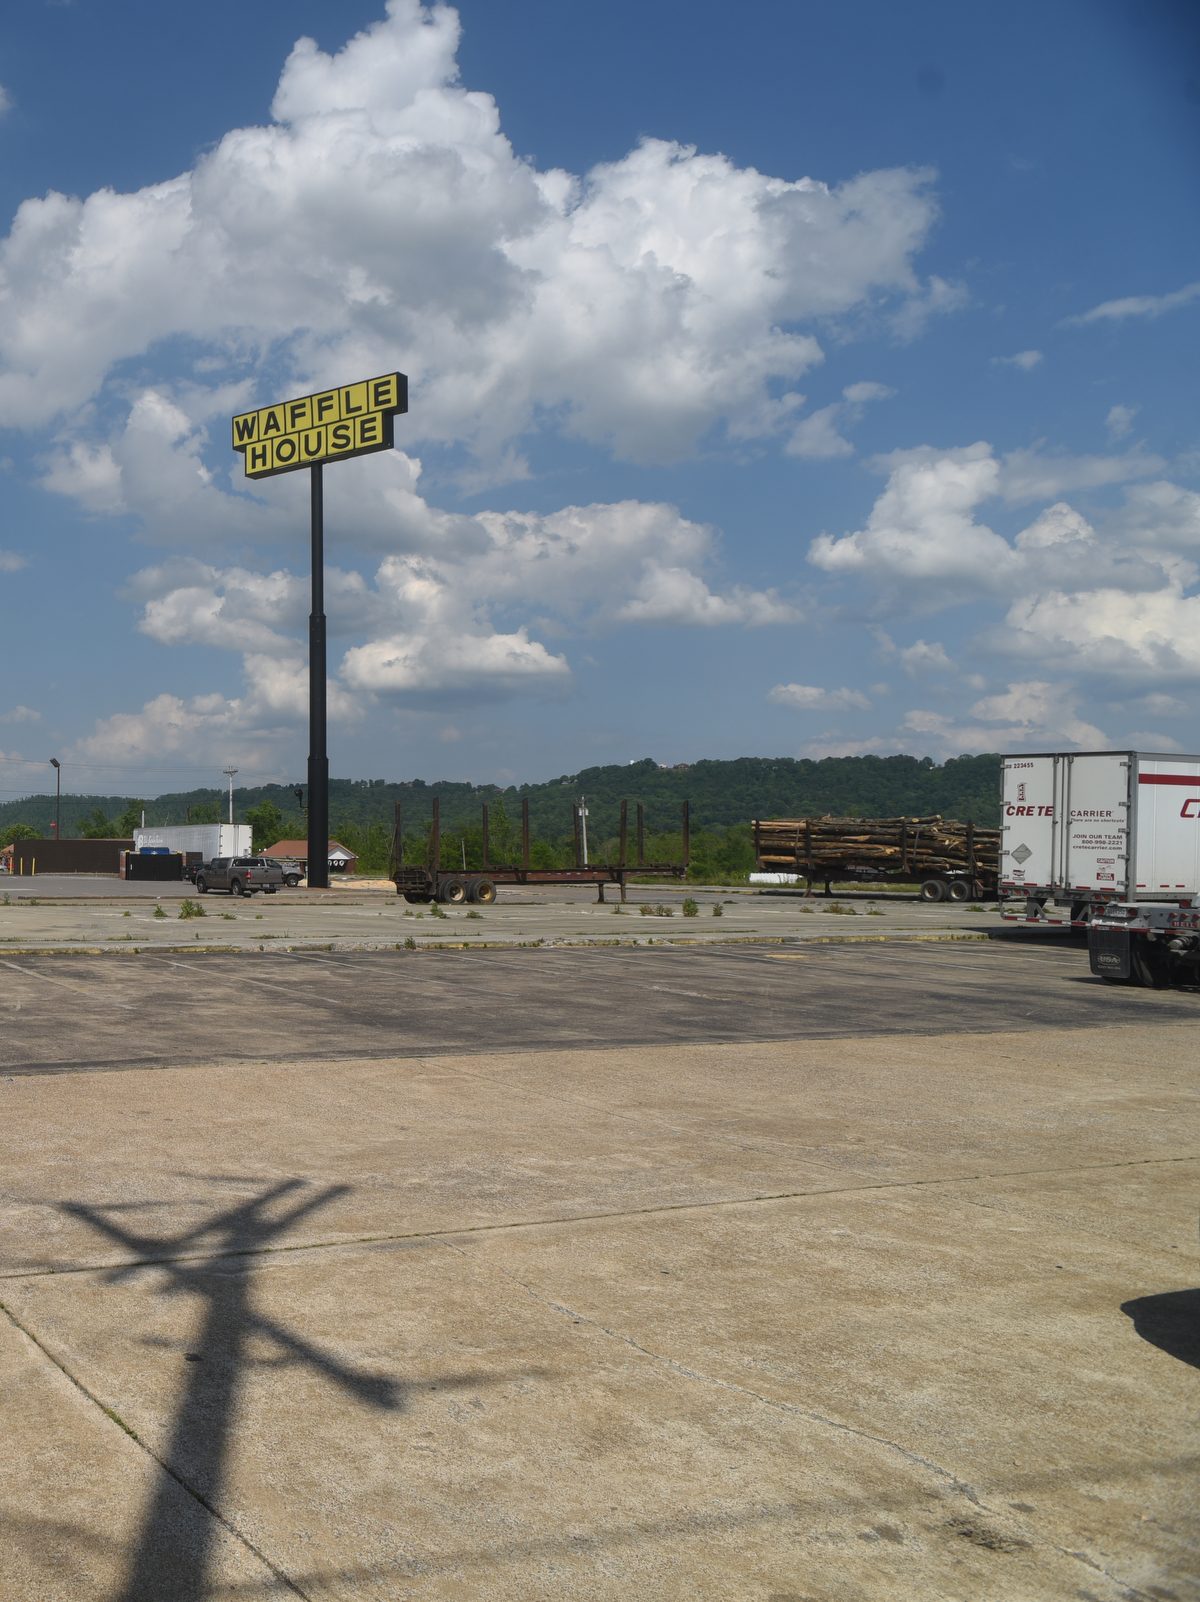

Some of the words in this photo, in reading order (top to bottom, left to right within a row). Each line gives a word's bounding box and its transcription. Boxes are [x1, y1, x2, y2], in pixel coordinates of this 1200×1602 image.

[235, 379, 392, 442] WAFFLE
[251, 416, 377, 470] HOUSE
[1006, 805, 1054, 817] CRETE
[1180, 798, 1200, 818] C
